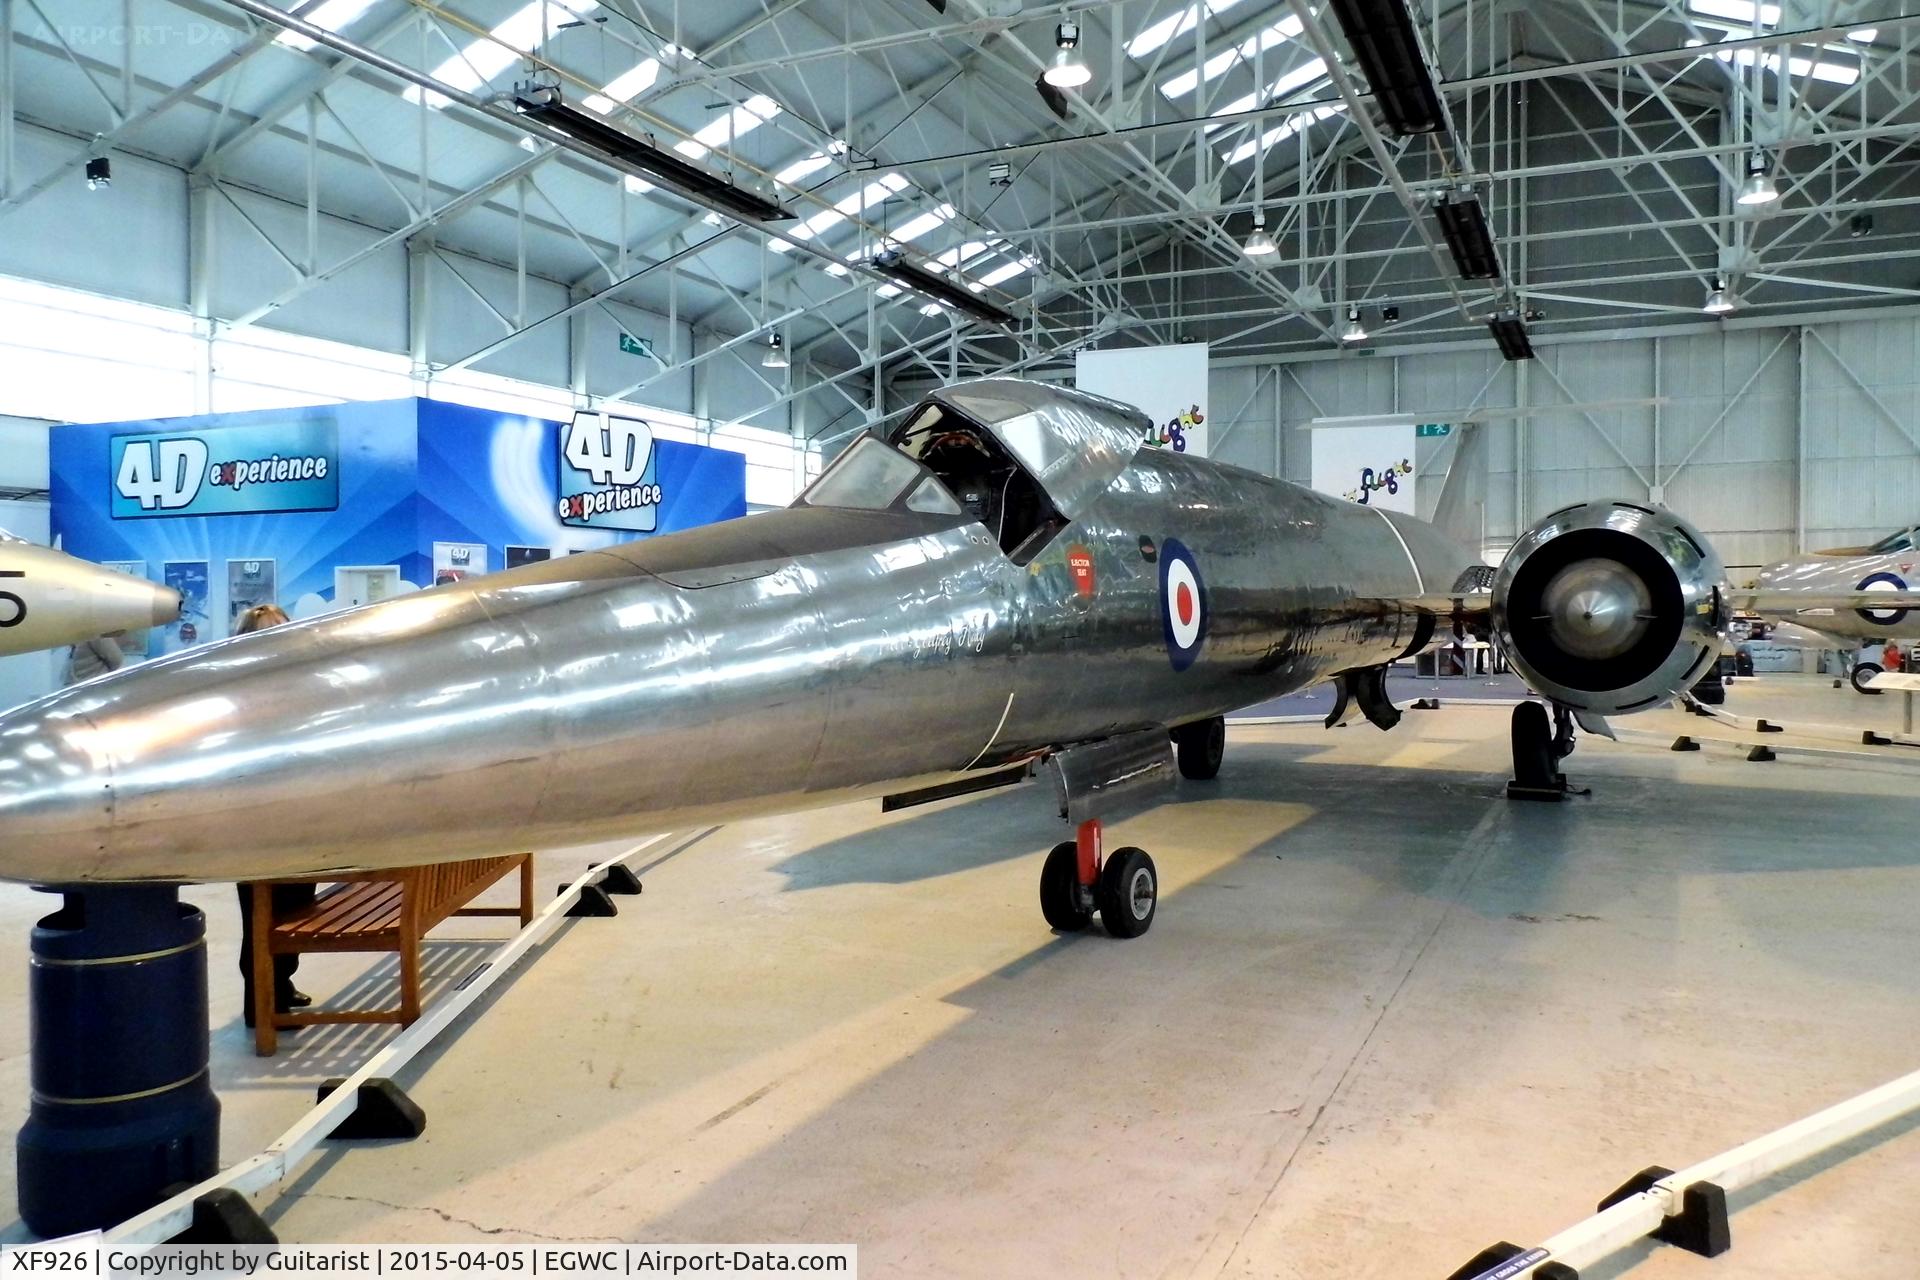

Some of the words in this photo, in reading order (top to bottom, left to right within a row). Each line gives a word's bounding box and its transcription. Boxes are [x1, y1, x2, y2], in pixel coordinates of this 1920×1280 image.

[116, 437, 208, 510] 4D
[210, 455, 328, 490] experience
[566, 411, 653, 486] 4D
[559, 483, 662, 523] experience
